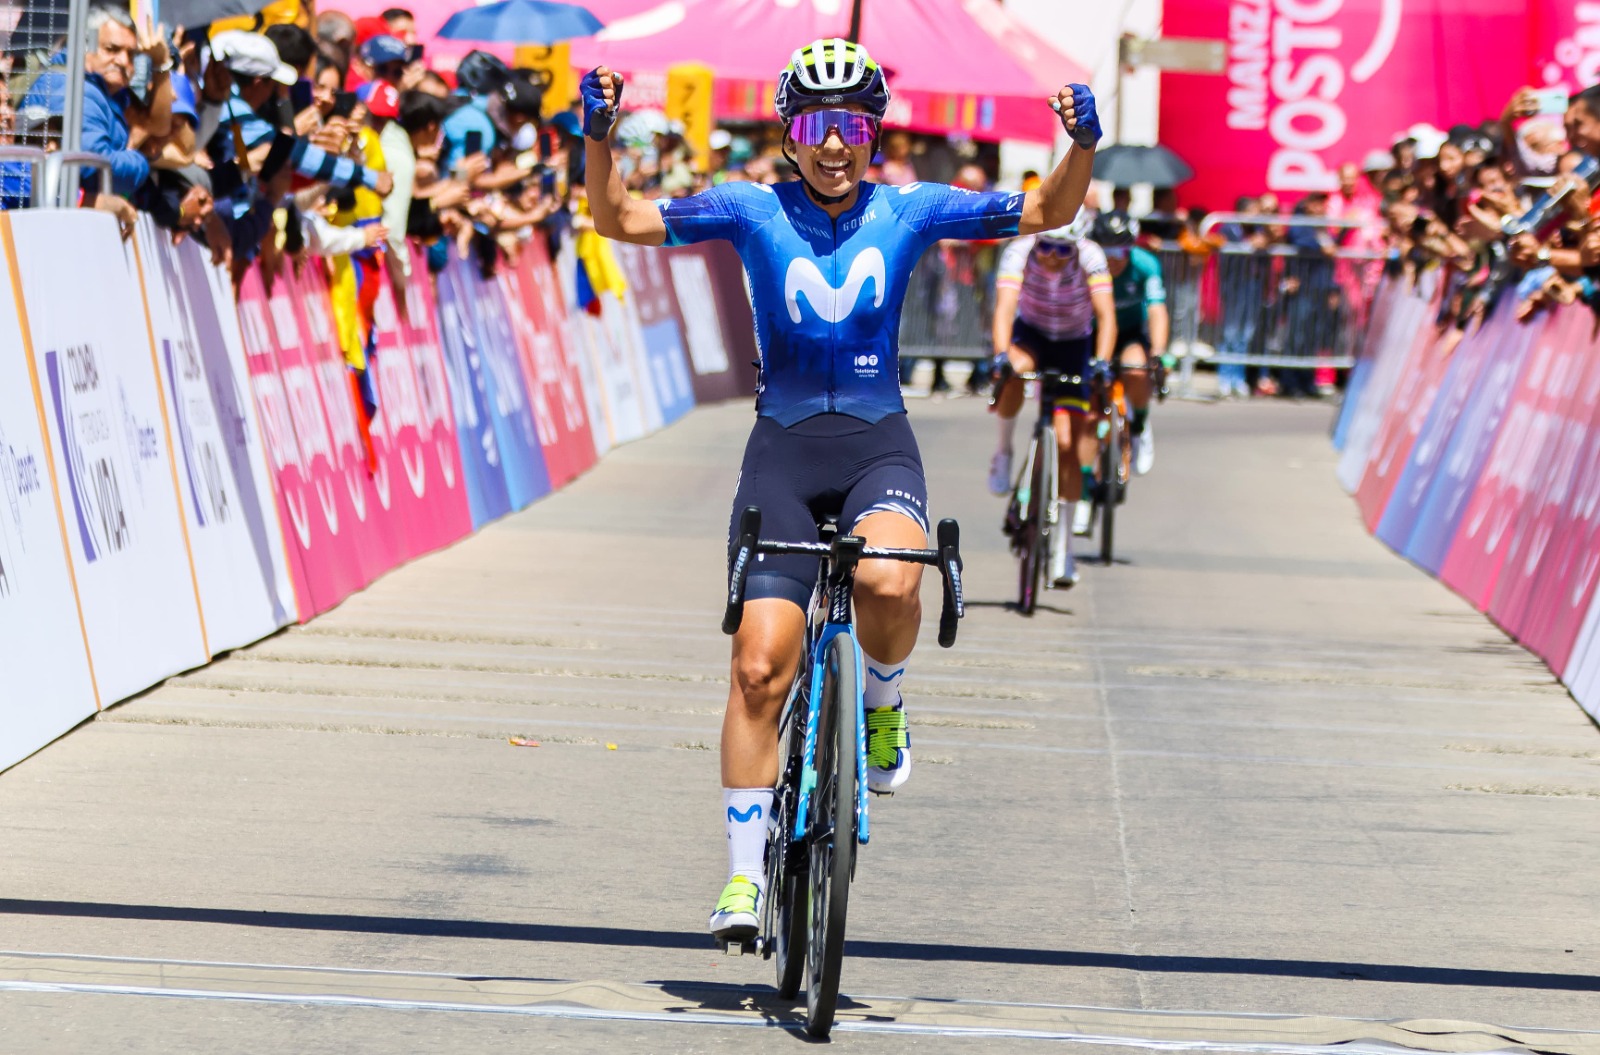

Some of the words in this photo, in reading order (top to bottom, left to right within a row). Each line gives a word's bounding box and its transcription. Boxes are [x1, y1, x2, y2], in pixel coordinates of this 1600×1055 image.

[1226, 0, 1270, 130] MANZ
[843, 209, 876, 231] GOBIK
[886, 489, 922, 507] GOBIK
[731, 545, 749, 593] SRAM
[949, 560, 963, 607] SRAM
